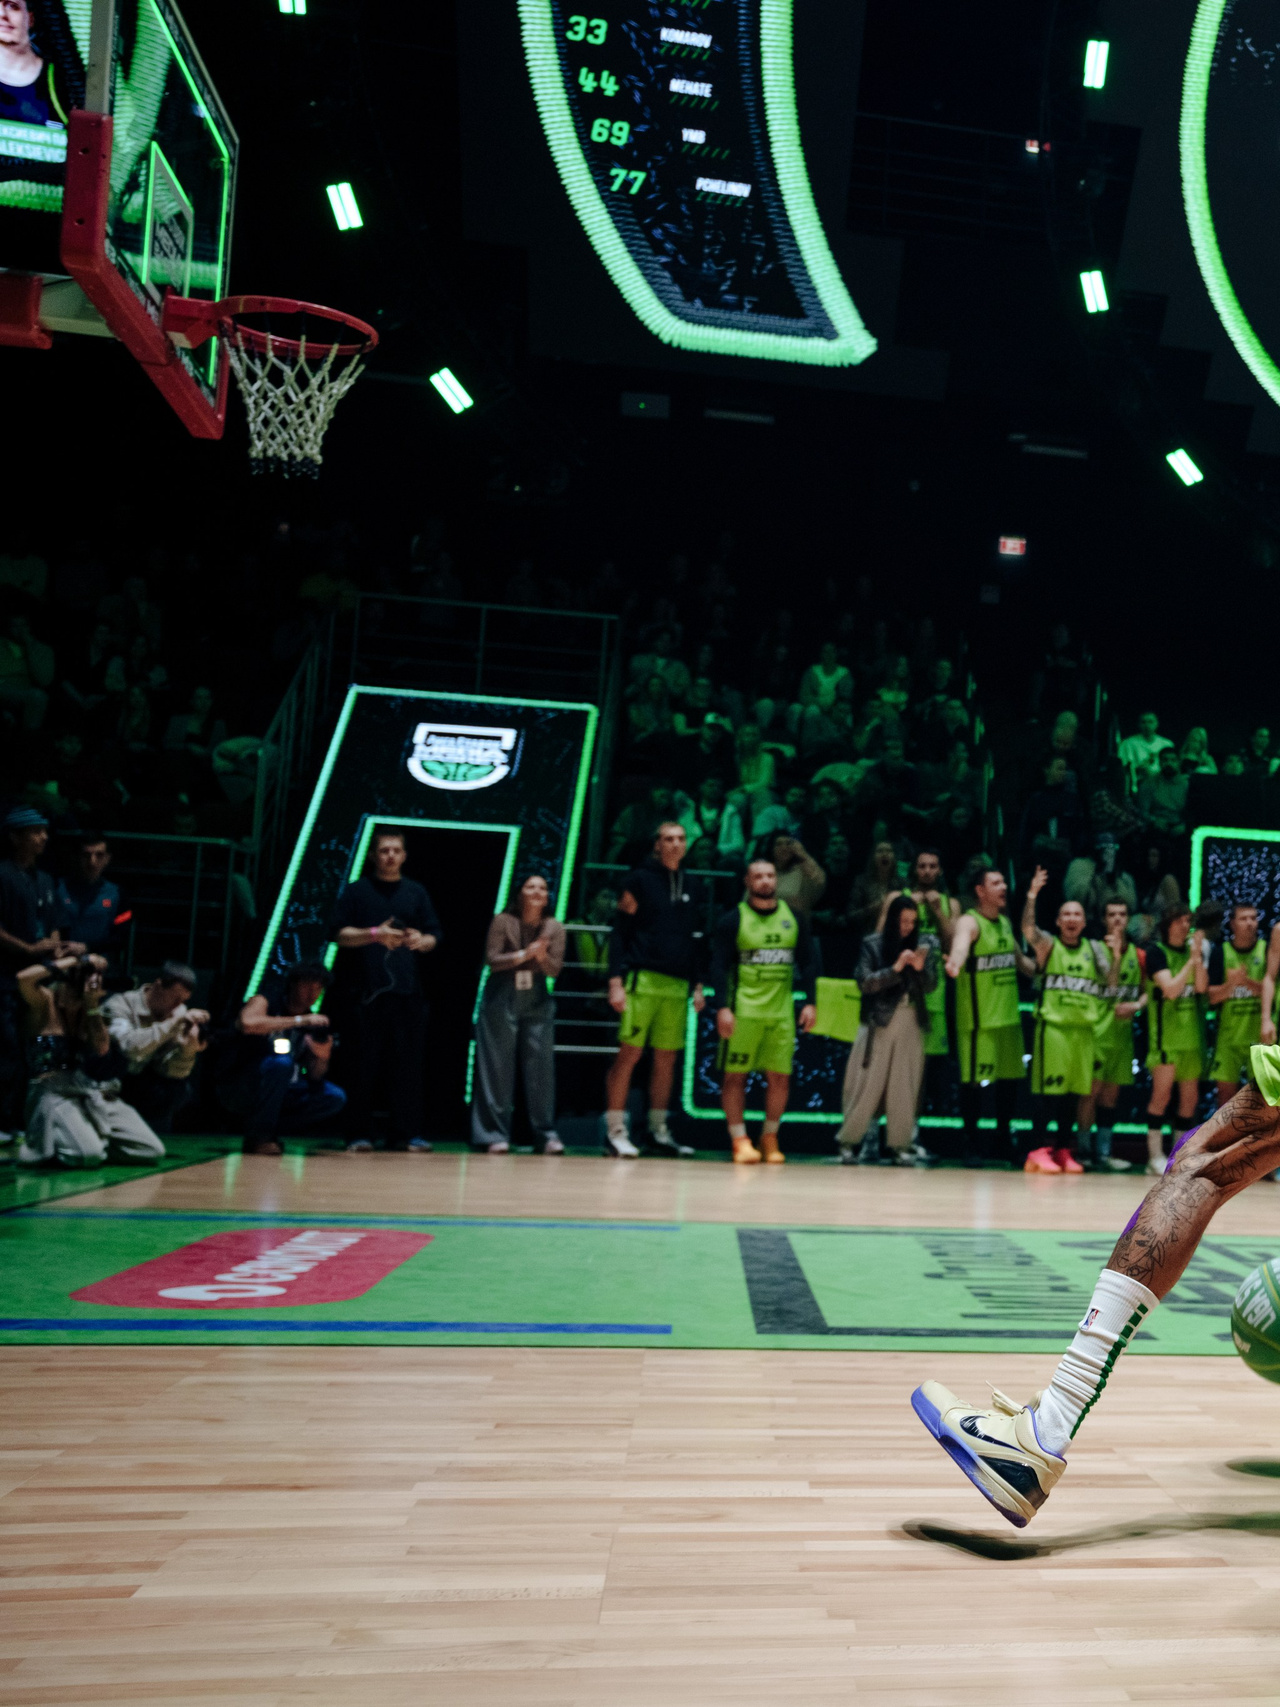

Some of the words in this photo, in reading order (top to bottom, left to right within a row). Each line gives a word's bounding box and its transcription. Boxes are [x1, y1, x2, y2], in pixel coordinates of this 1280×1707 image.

[566, 15, 609, 45] 33
[578, 67, 620, 97] 44
[590, 118, 630, 146] 69
[609, 167, 647, 195] 77
